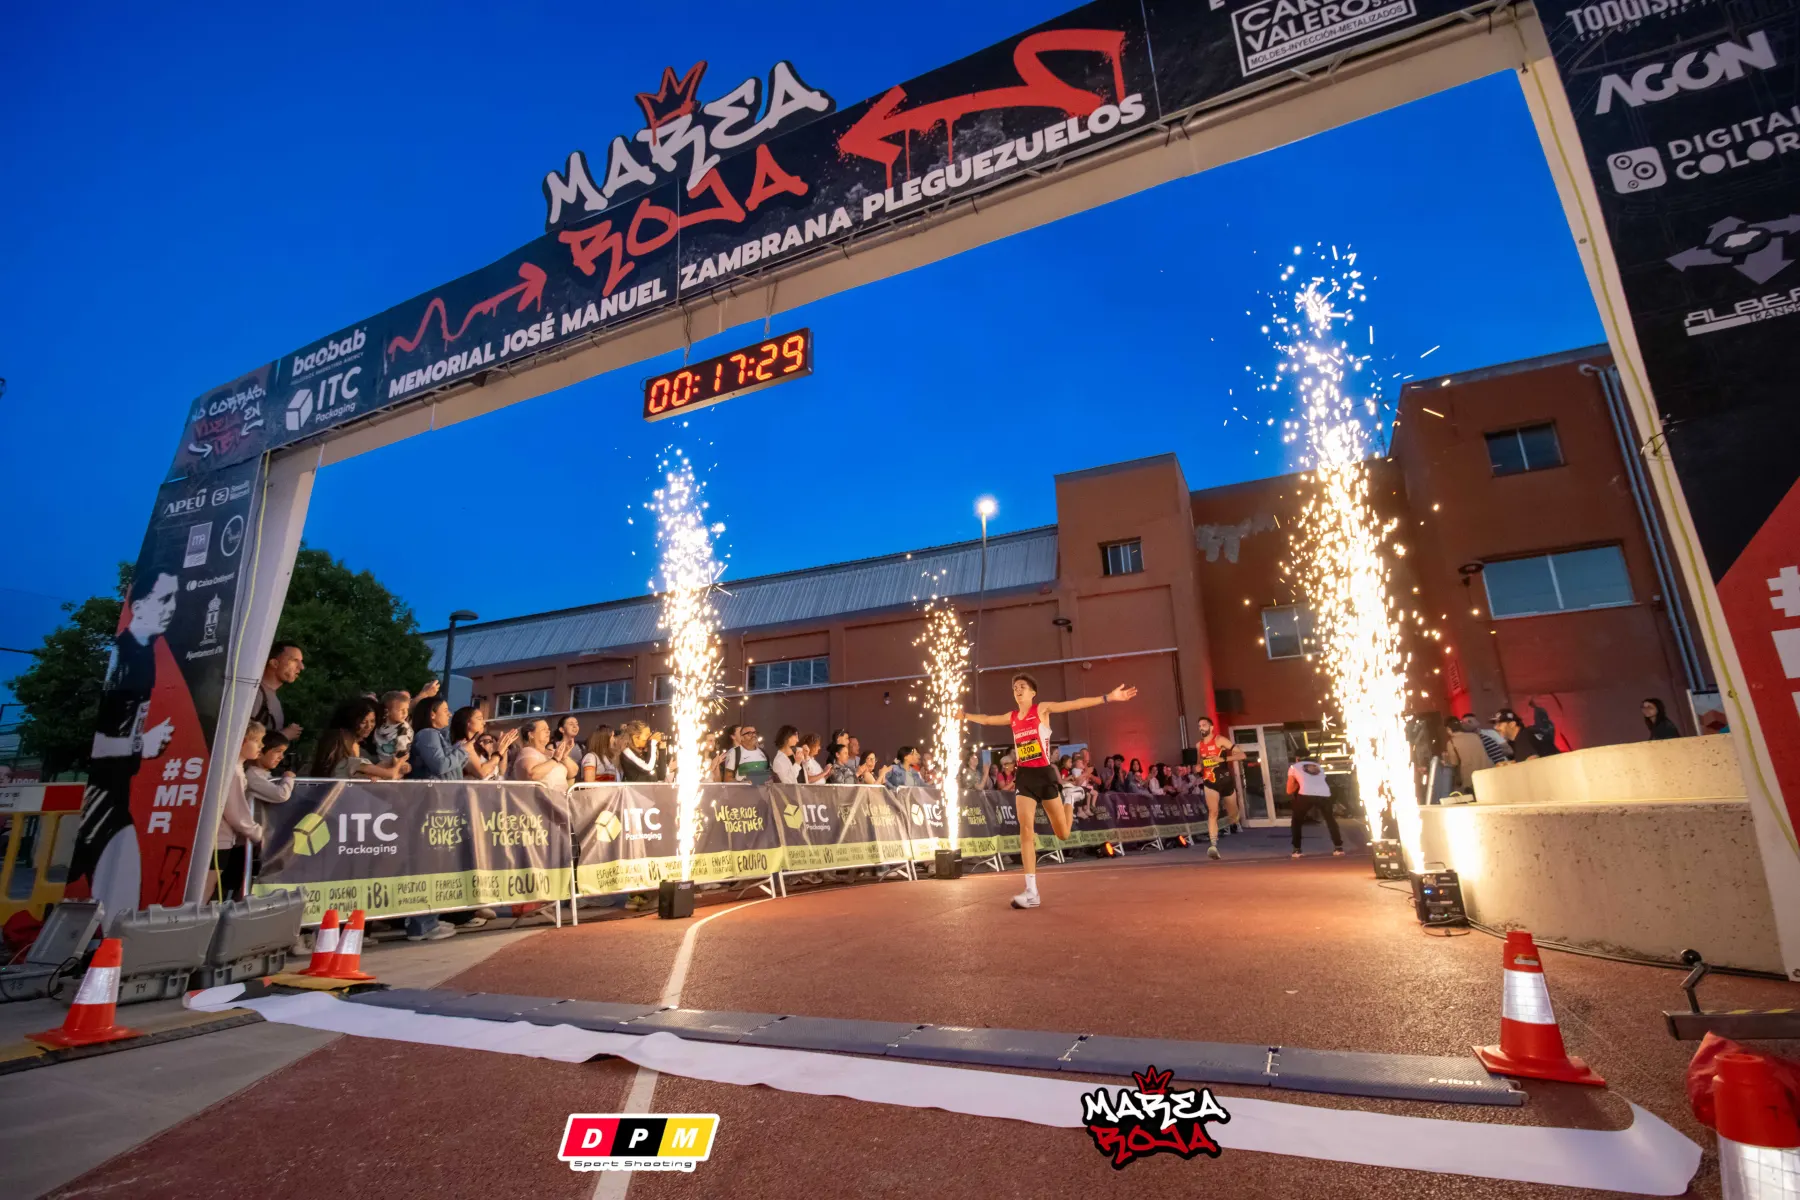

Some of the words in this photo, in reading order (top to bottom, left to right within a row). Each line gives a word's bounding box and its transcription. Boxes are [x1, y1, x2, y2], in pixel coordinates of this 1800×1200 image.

[546, 60, 831, 223] MAREA
[558, 143, 809, 298] ROJA
[388, 340, 496, 399] MEMORIAL
[500, 316, 555, 358] JOSÉ
[561, 277, 668, 336] MANUEL
[680, 206, 853, 291] ZAMBRANA
[862, 93, 1147, 222] PLEGUEZUELOS
[292, 328, 367, 378] baobab
[648, 334, 805, 414] 00:17:29
[317, 366, 362, 411] ITC
[315, 402, 356, 424] Packaging
[153, 784, 199, 807] MR
[147, 811, 172, 834] R
[623, 808, 662, 832] ITC
[803, 804, 830, 823] ITC
[1001, 805, 1016, 820] ITC
[338, 812, 399, 843] ITC
[338, 845, 398, 856] Packaging
